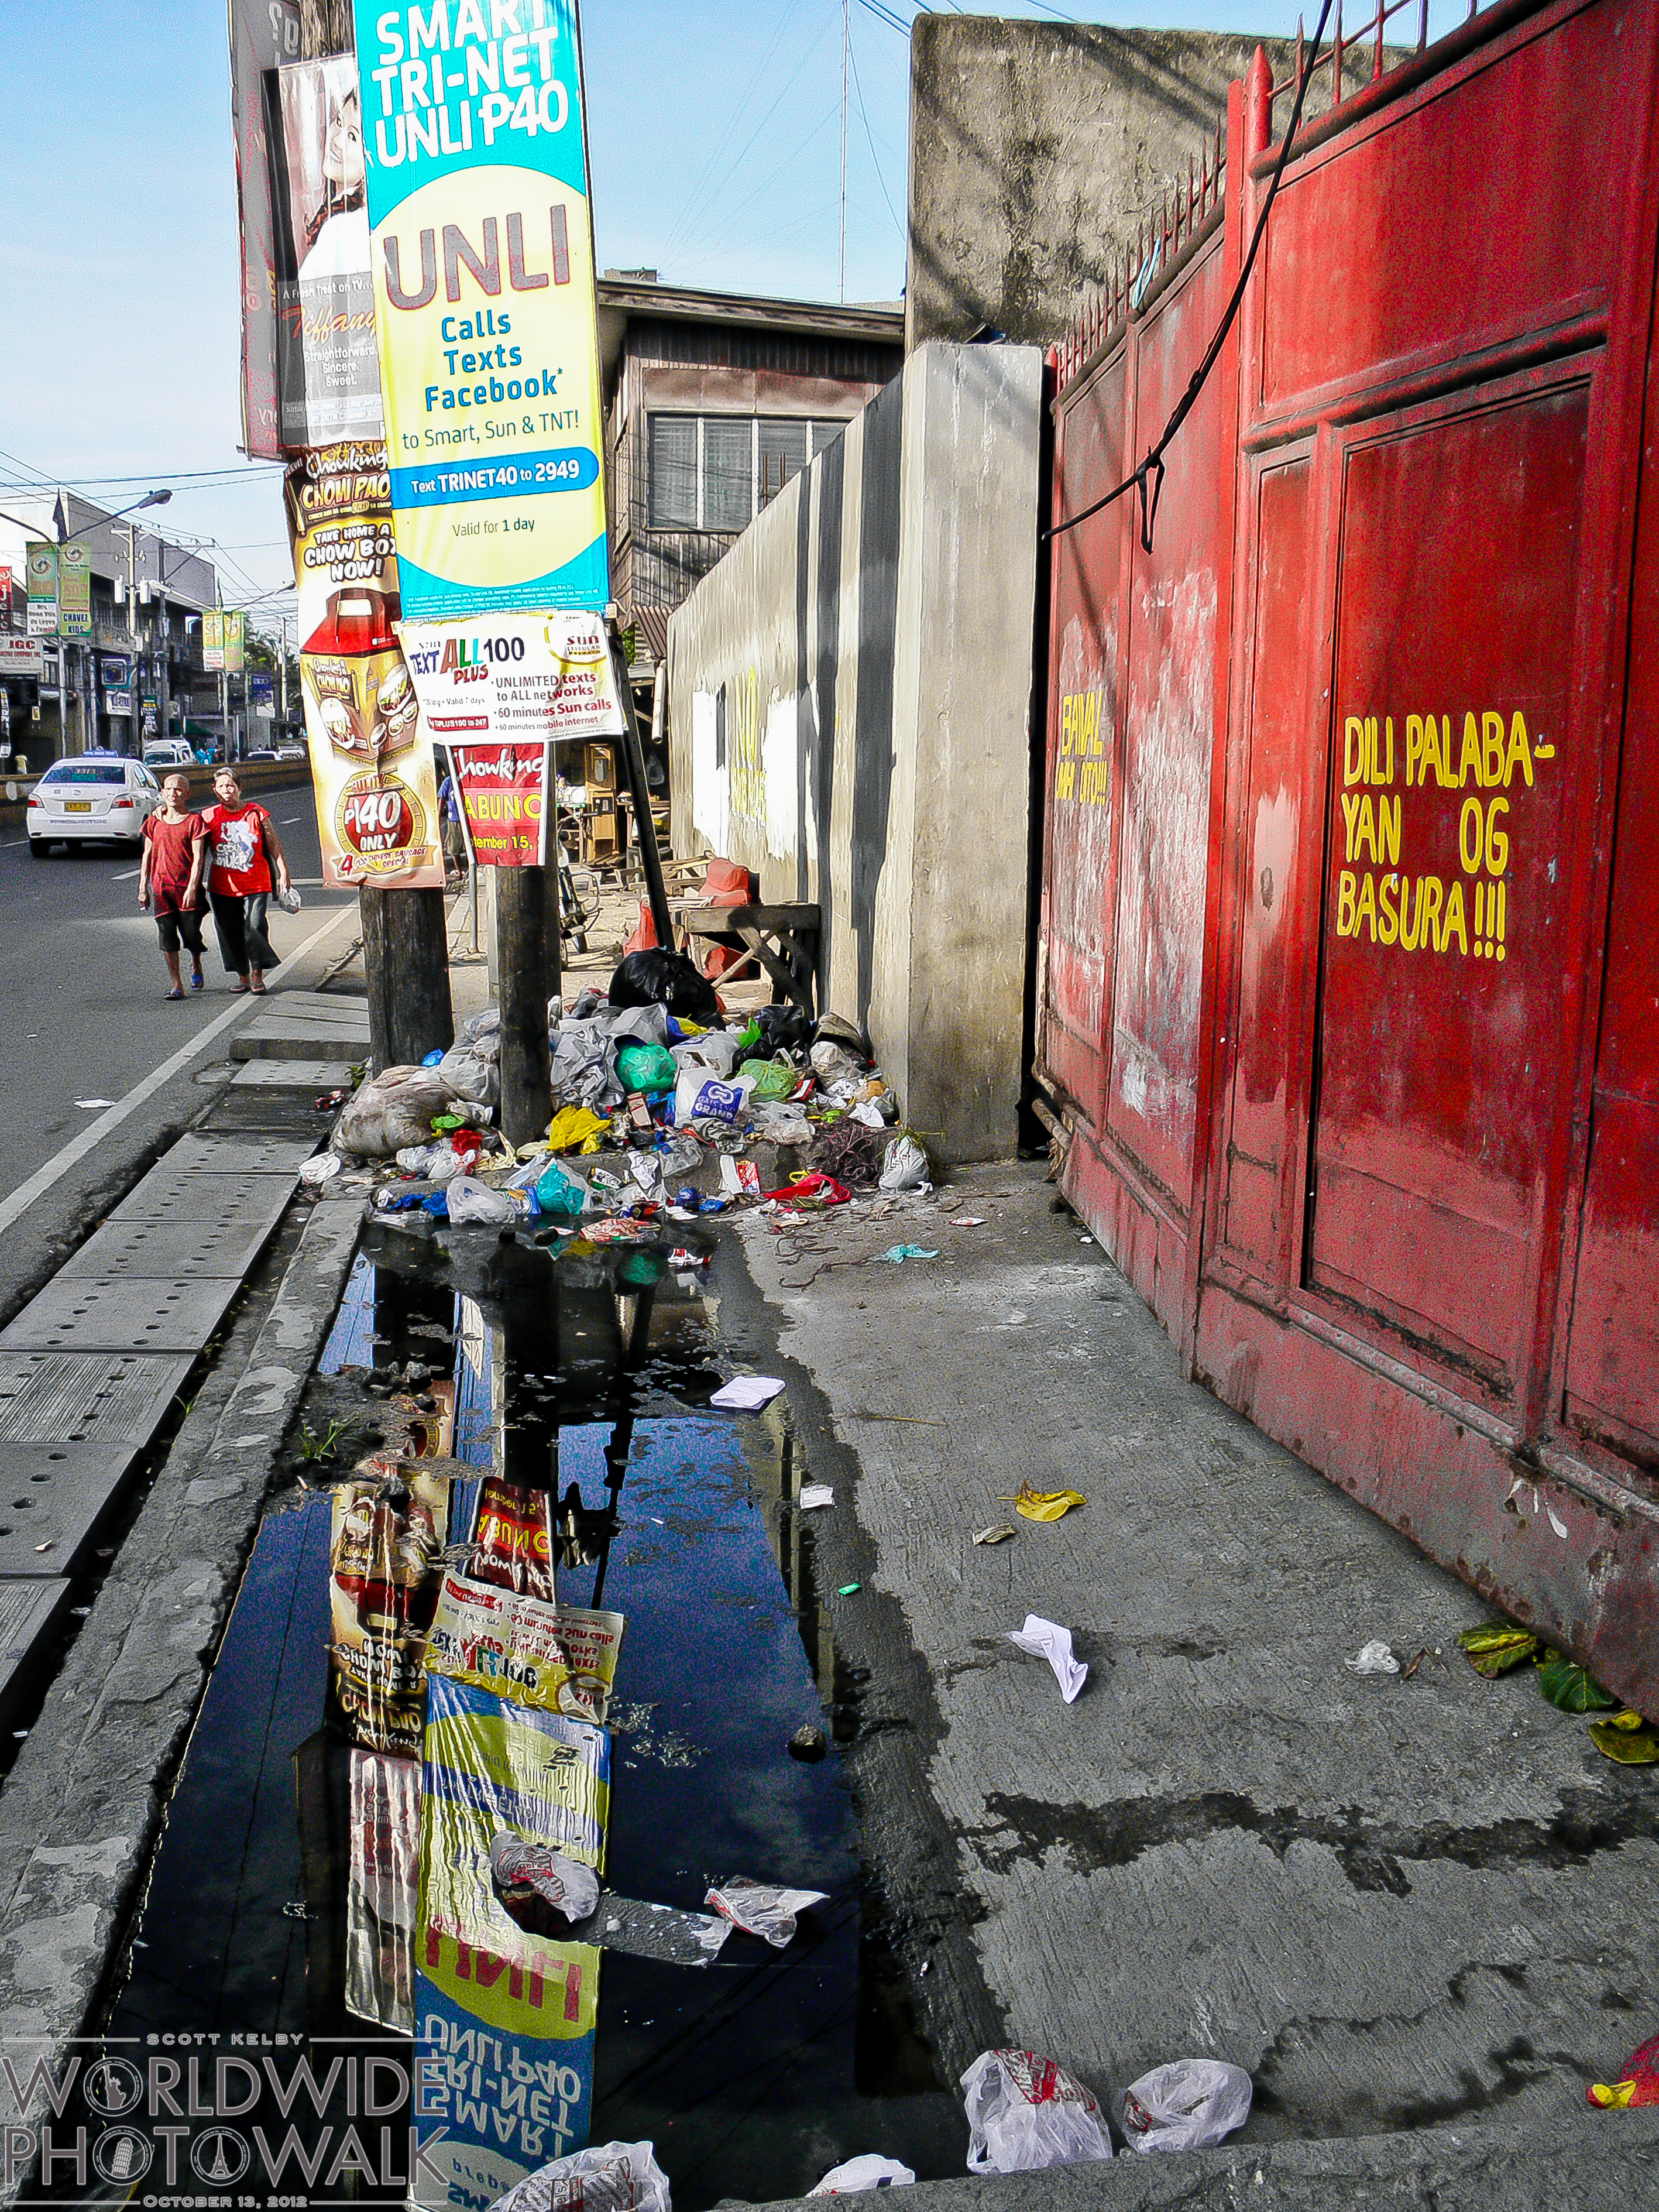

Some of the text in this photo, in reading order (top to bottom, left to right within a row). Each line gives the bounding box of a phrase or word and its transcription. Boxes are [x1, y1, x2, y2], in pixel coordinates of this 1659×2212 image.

[372, 27, 558, 116] TRI-NET
[376, 100, 472, 167] UNLI
[383, 204, 570, 310] UNLI
[442, 310, 511, 342] Calls
[444, 344, 522, 375] Texts
[402, 409, 579, 450] to Smart, Sun & TNT!
[354, 472, 391, 500] PAO
[411, 459, 580, 494] Text TRINET40 to 2949
[315, 525, 390, 545] TAKE HOME A
[452, 518, 535, 537] Valid for 1 day
[305, 540, 355, 567] CHOW
[331, 558, 382, 582] NOW!
[63, 613, 88, 622] CHAVEZ
[68, 625, 84, 634] KIDS
[409, 650, 439, 675] TEXT
[454, 664, 489, 685] PLUS
[496, 673, 596, 688] UNLIMITED texts
[497, 684, 593, 702] to ALL networks
[498, 699, 612, 718] 60 minutes Sun calls
[508, 722, 535, 731] minutes
[537, 721, 564, 730] mobile
[1344, 711, 1555, 788] DILI PALABA-
[454, 747, 544, 783] howking
[360, 832, 397, 852] ONLY
[471, 835, 534, 850] tember 15,
[1341, 793, 1510, 876] YAN OG
[340, 854, 353, 876] 4
[394, 848, 426, 858] SAUSAGE
[1337, 870, 1506, 962] BASURA!!!
[695, 1102, 733, 1119] GRAND
